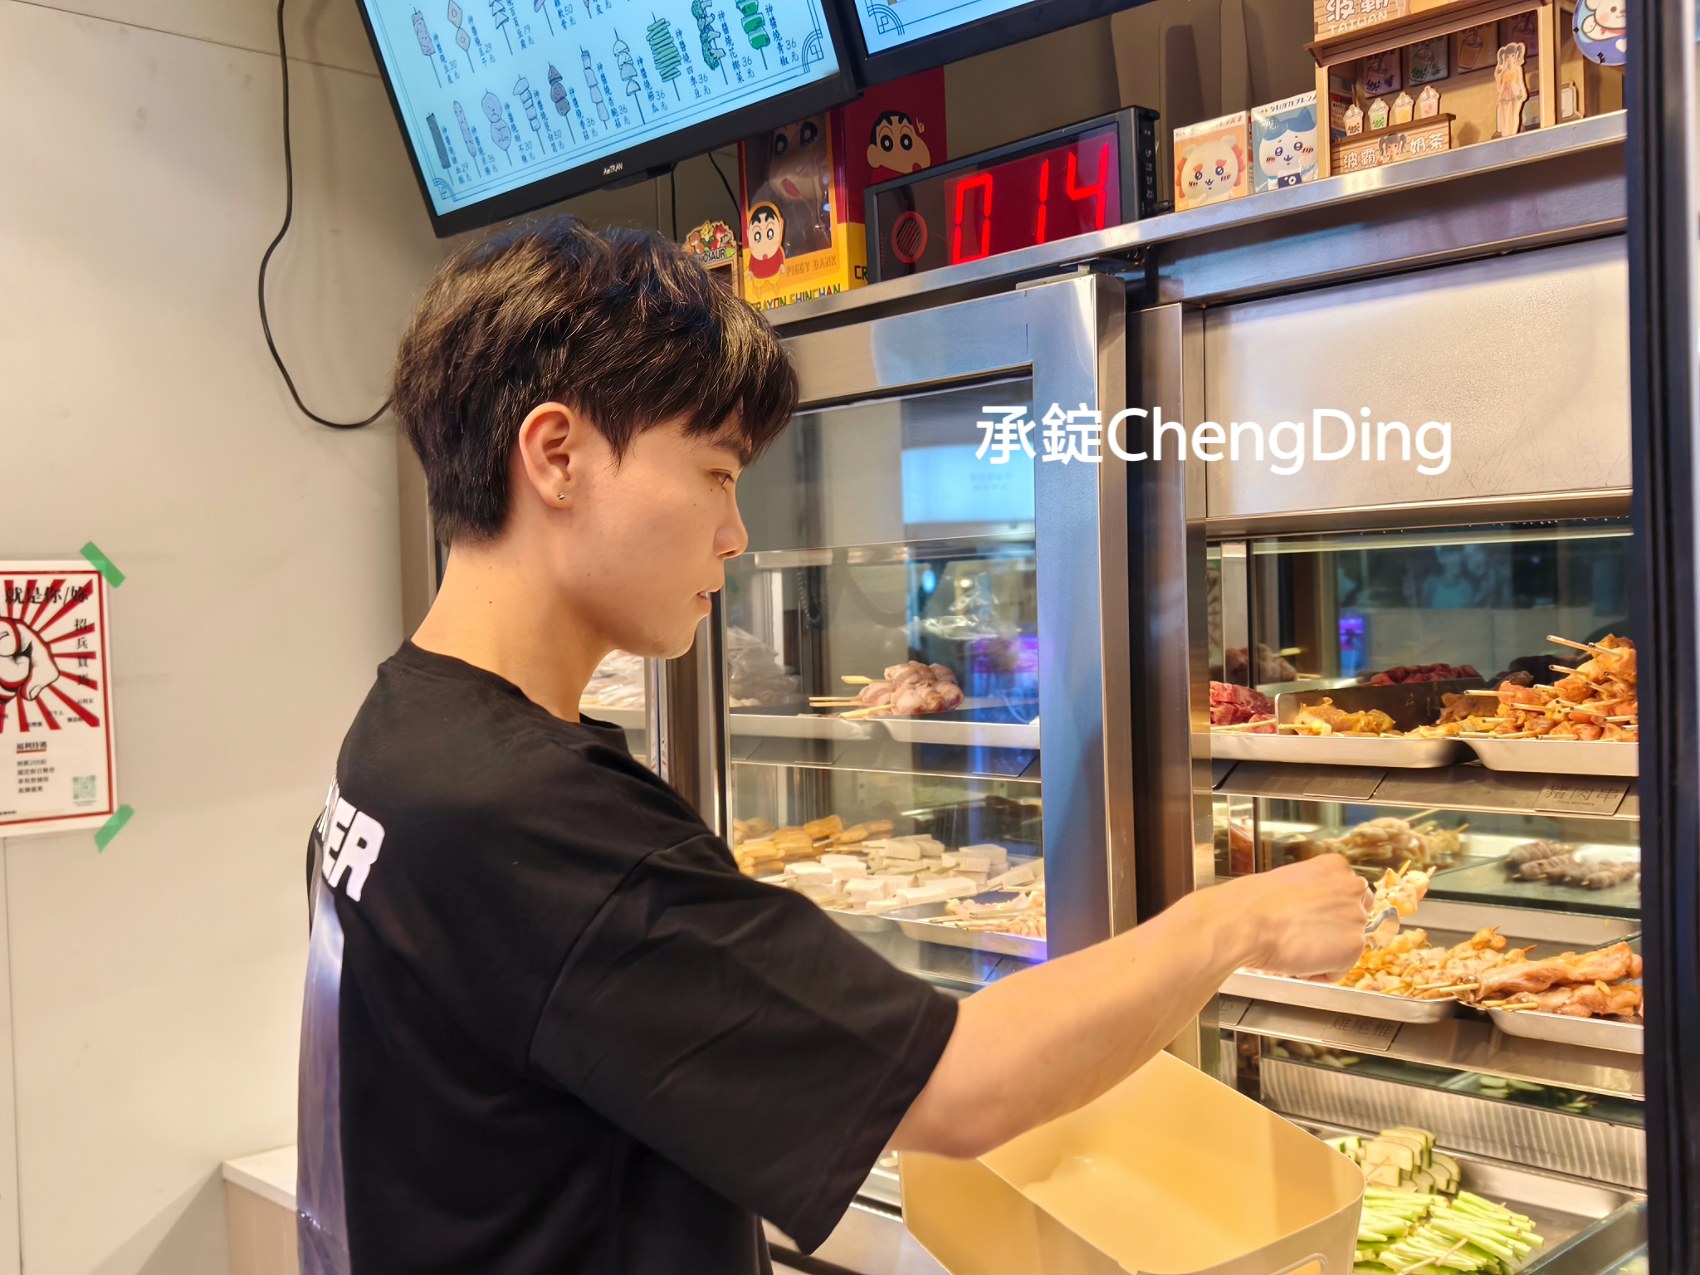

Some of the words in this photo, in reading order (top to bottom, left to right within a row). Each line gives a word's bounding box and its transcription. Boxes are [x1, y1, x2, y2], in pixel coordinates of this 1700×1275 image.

[1329, 11, 1388, 35] TAIWAN
[1410, 131, 1445, 155] 奶茶
[951, 142, 1109, 266] 014
